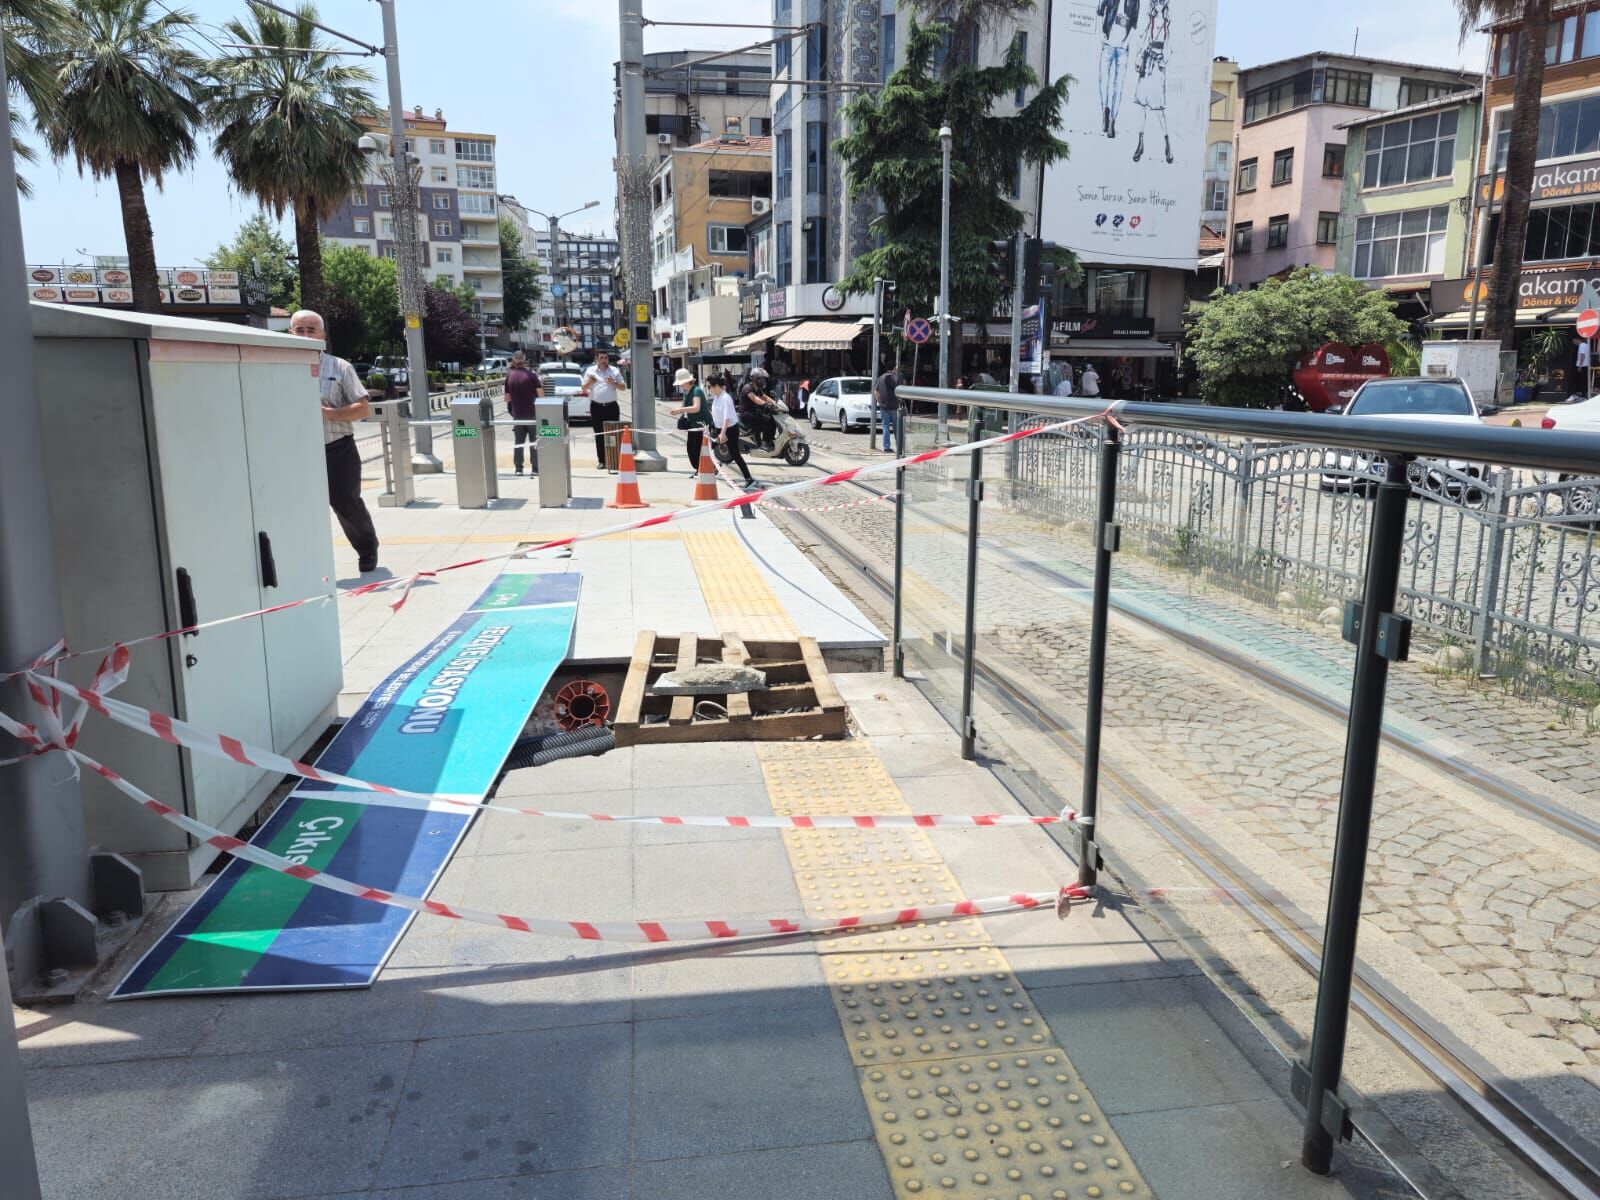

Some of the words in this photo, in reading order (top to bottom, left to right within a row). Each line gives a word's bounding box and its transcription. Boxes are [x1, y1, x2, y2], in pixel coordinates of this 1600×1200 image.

[1541, 186, 1572, 198] Döner
[1522, 297, 1554, 308] Döner
[1554, 295, 1562, 305] &
[400, 655, 493, 735] İSTASYONU
